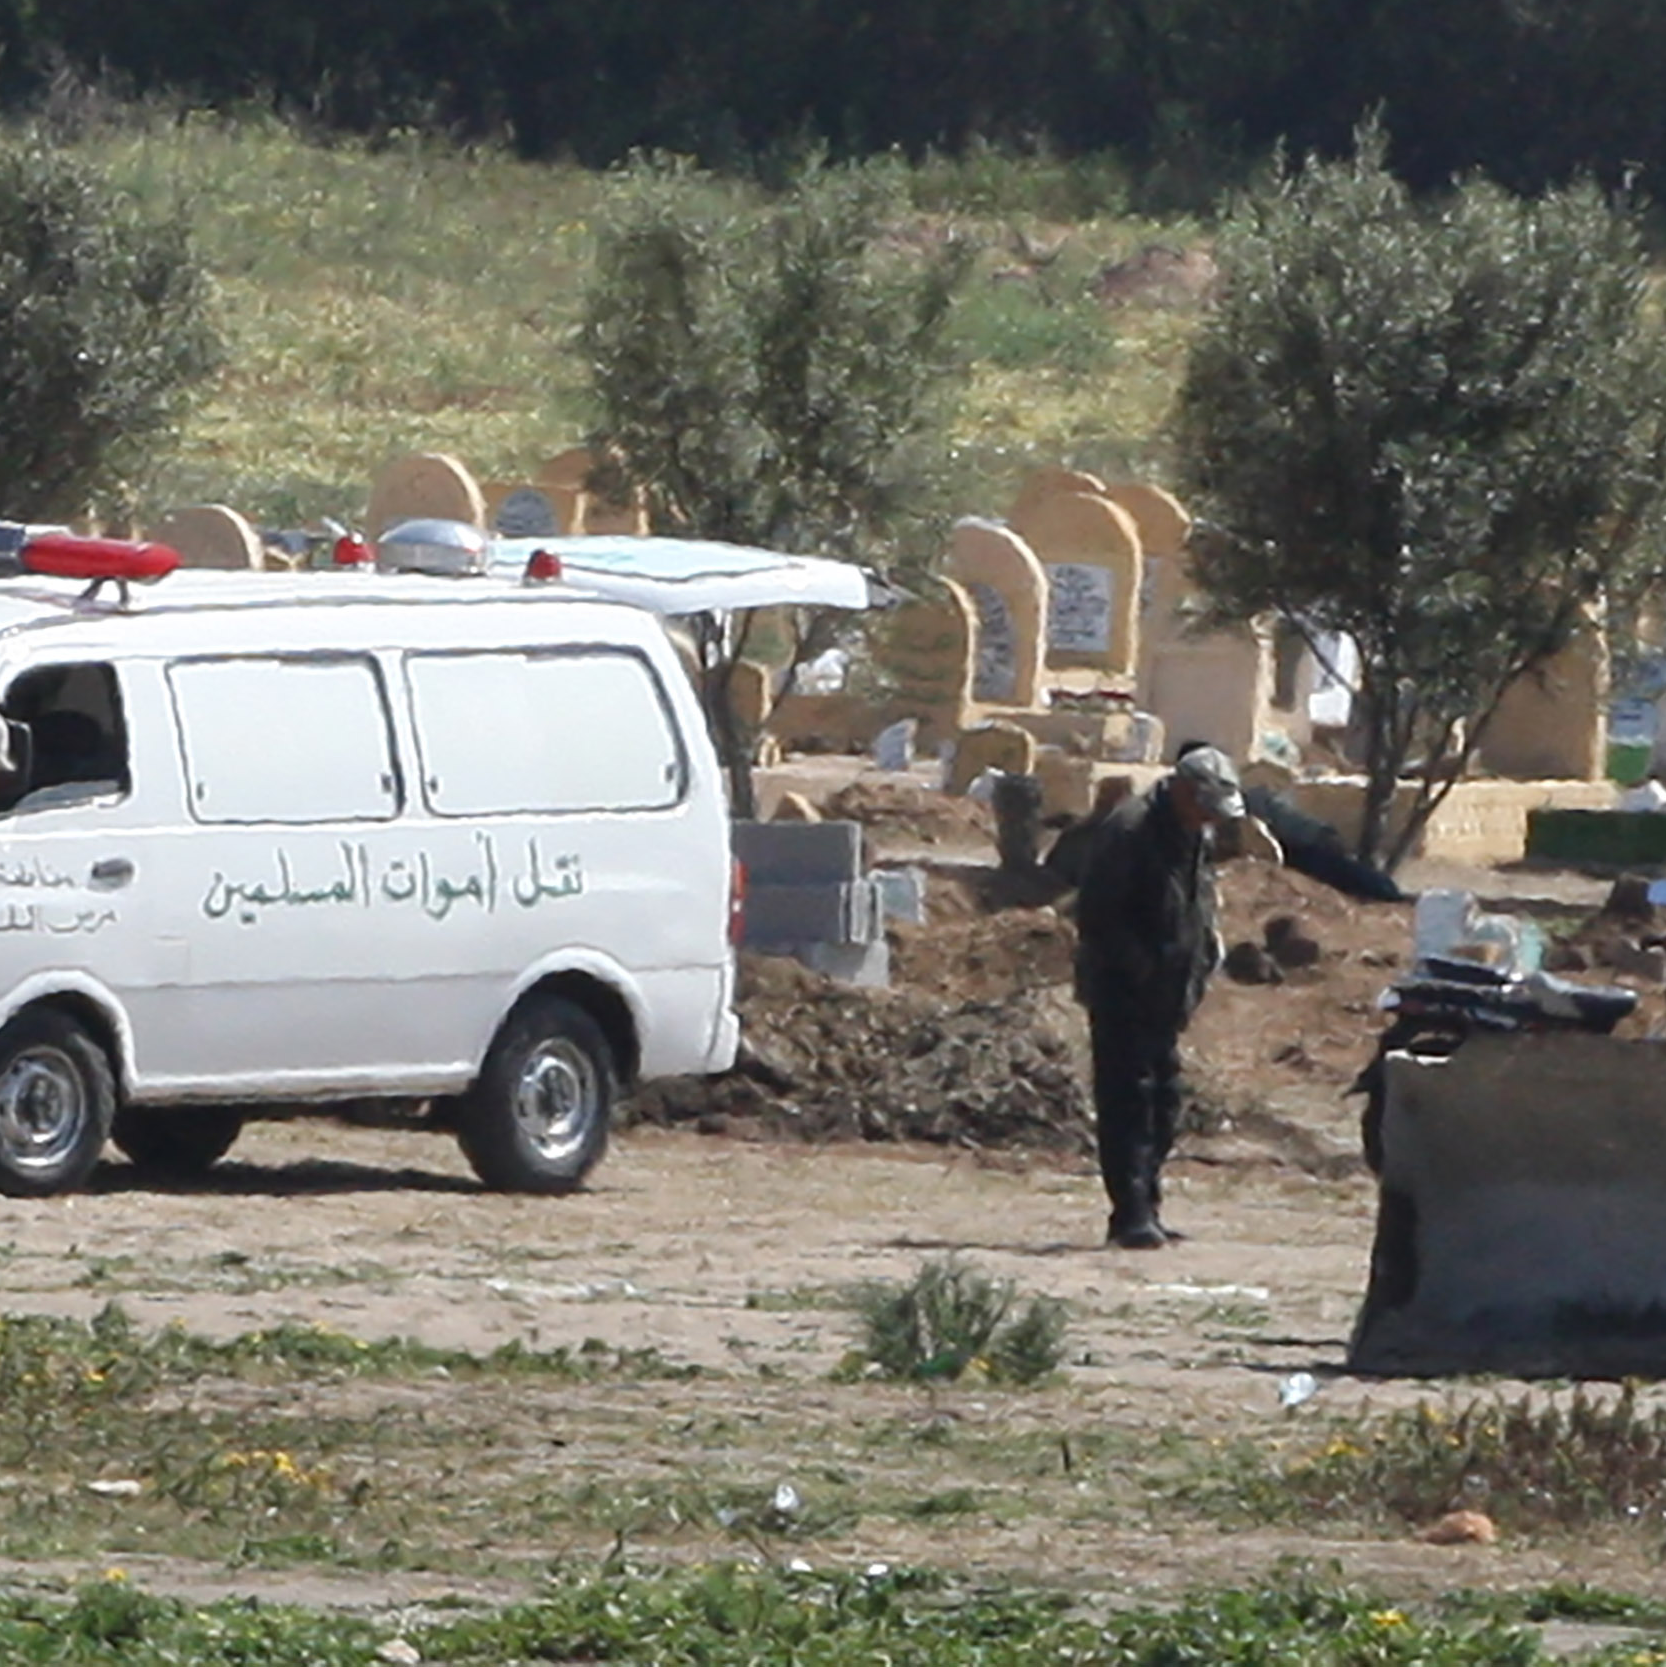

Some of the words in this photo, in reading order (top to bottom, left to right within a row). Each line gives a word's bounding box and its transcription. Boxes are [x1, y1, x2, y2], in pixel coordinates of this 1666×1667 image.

[202, 840, 371, 924] المسلمين
[381, 831, 498, 921] أموات
[513, 835, 585, 907] نقل
